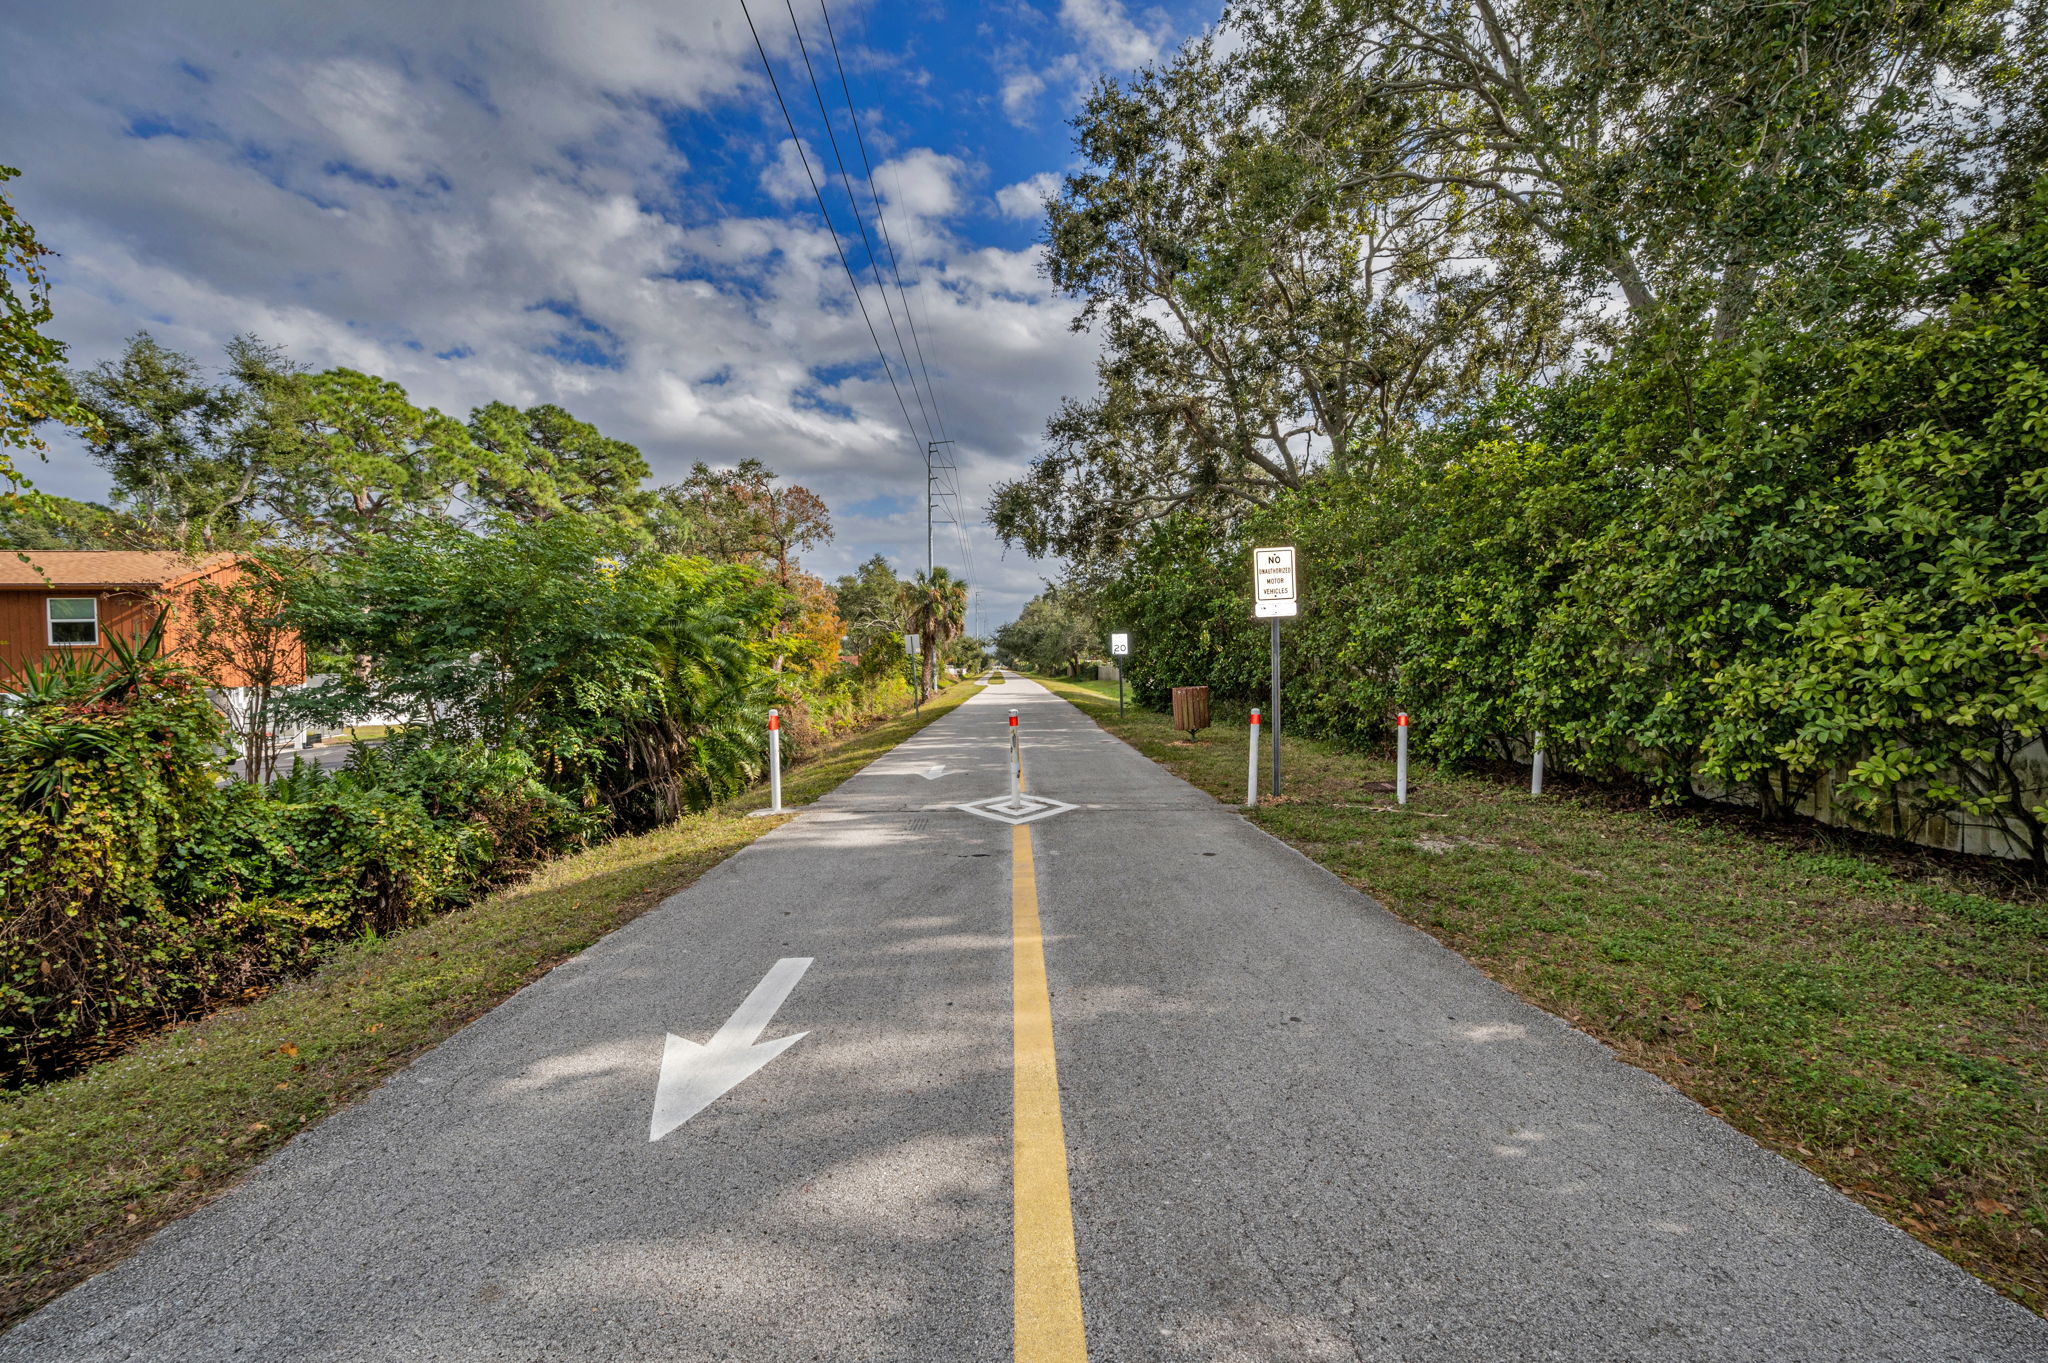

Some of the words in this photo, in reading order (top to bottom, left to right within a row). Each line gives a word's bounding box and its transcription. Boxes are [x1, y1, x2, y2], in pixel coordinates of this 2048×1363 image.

[1268, 556, 1281, 564] NO
[1259, 567, 1291, 575] UNAUTHORIZED
[1114, 644, 1126, 652] 20
